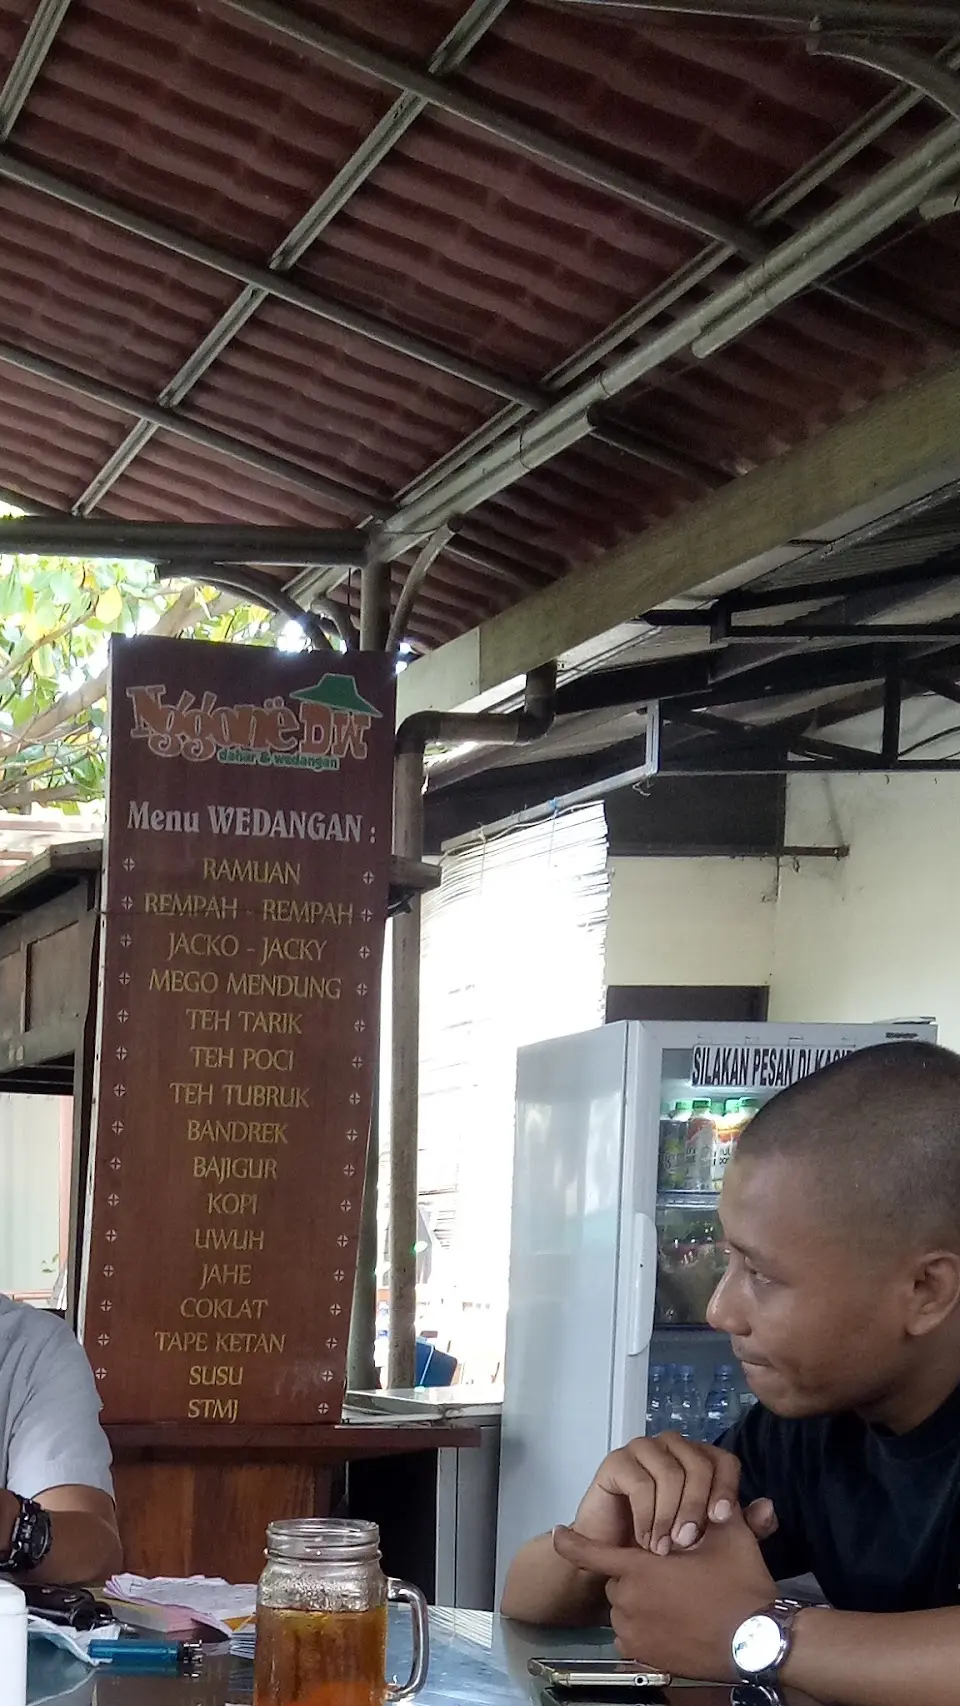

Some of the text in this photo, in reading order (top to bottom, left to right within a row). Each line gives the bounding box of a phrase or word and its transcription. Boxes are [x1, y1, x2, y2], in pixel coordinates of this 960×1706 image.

[272, 752, 339, 771] wedangan
[126, 800, 200, 833] Menu
[206, 804, 364, 843] WEDANGAN
[203, 857, 300, 885] RAMUAN
[144, 893, 237, 920] REMPAH
[263, 899, 353, 925] REMPAH
[167, 932, 239, 961] JACKO
[260, 938, 327, 965] JACKY
[148, 969, 341, 999] MEGO MENDUNG
[186, 1009, 303, 1034] TEH TARIK
[190, 1046, 294, 1072] TEH POCI
[691, 1046, 749, 1087] SILAKAN
[752, 1048, 793, 1087] PESAN
[170, 1083, 309, 1109] TEH TUBRUK
[188, 1120, 288, 1144] BANDREK
[193, 1156, 277, 1185] BAJIGUR
[207, 1193, 258, 1215] KOPI
[194, 1229, 264, 1251] UWUH
[200, 1263, 252, 1290] JAHE
[180, 1298, 267, 1319] COKLAT
[155, 1331, 286, 1353] TAPE KETAN
[188, 1366, 243, 1386] SUSU
[187, 1399, 239, 1424] STMJ
